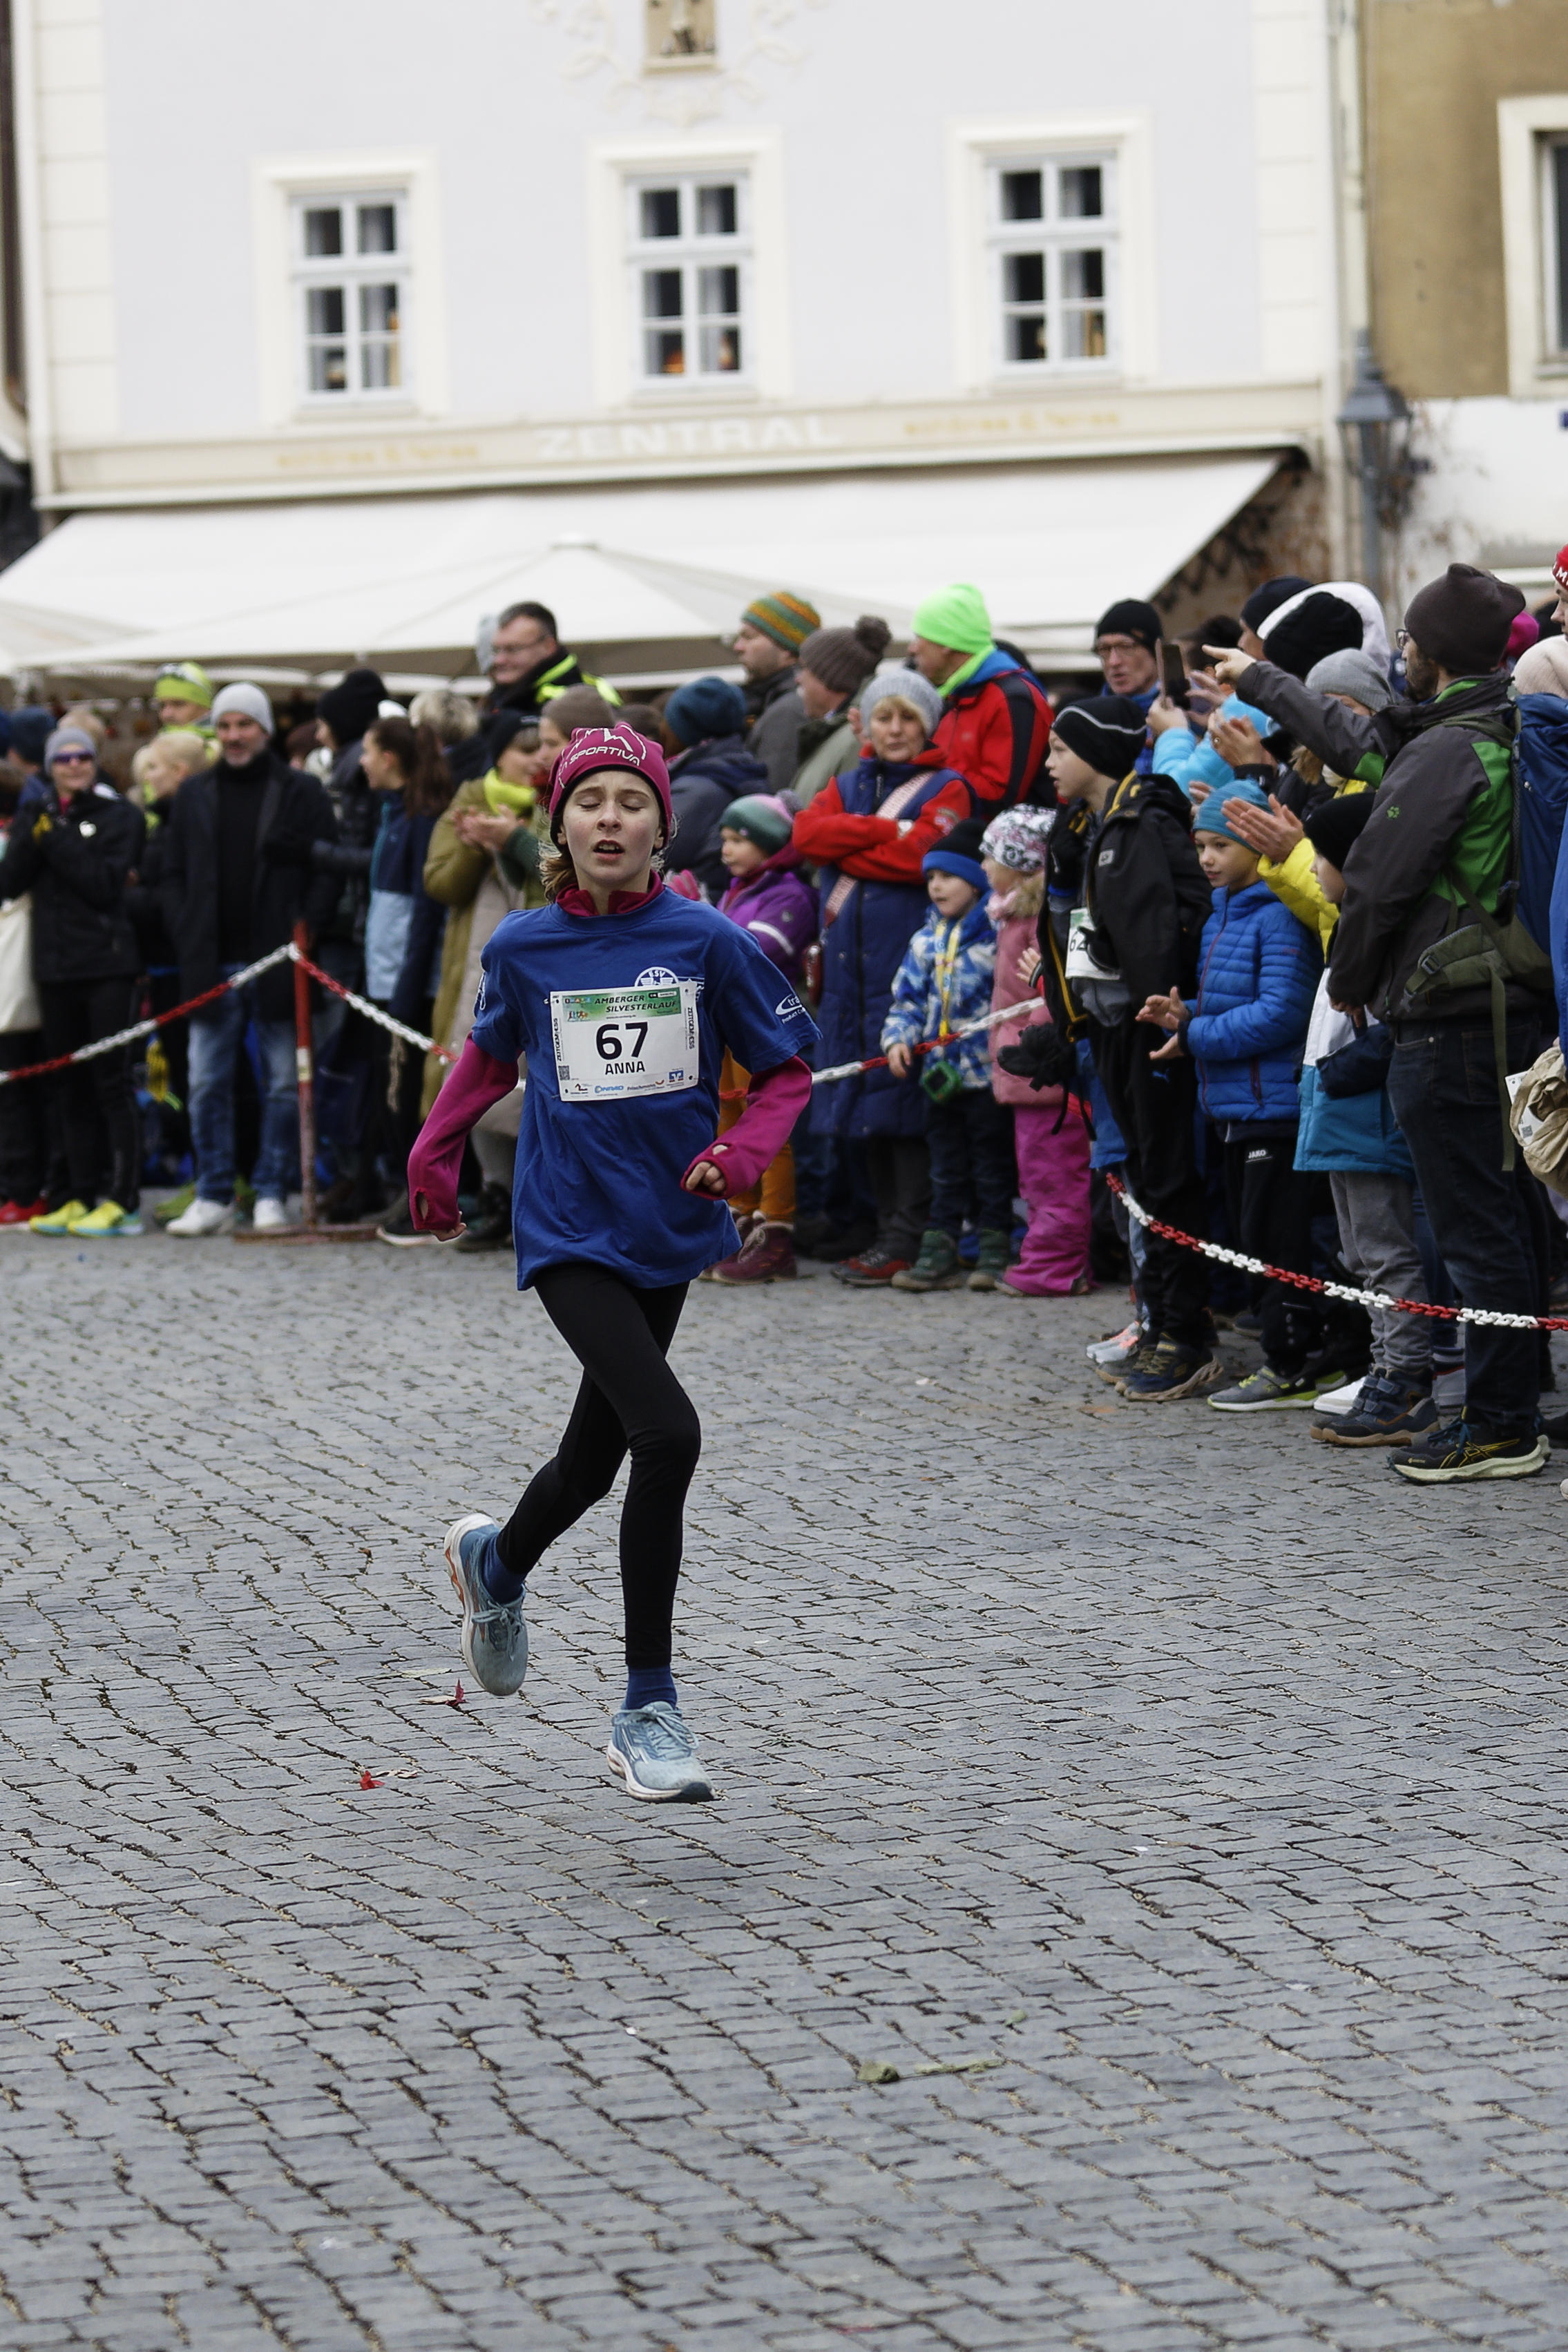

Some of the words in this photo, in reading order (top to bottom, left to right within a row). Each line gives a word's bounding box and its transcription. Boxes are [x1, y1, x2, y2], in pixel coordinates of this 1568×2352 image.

[535, 414, 842, 458] ZENTRAL
[569, 746, 640, 767] SPORTIVA
[594, 995, 645, 1005] AMBERGER
[606, 1000, 677, 1013] SILVESTERLAUF
[596, 1022, 648, 1060] 67
[605, 1061, 645, 1075] ANNA
